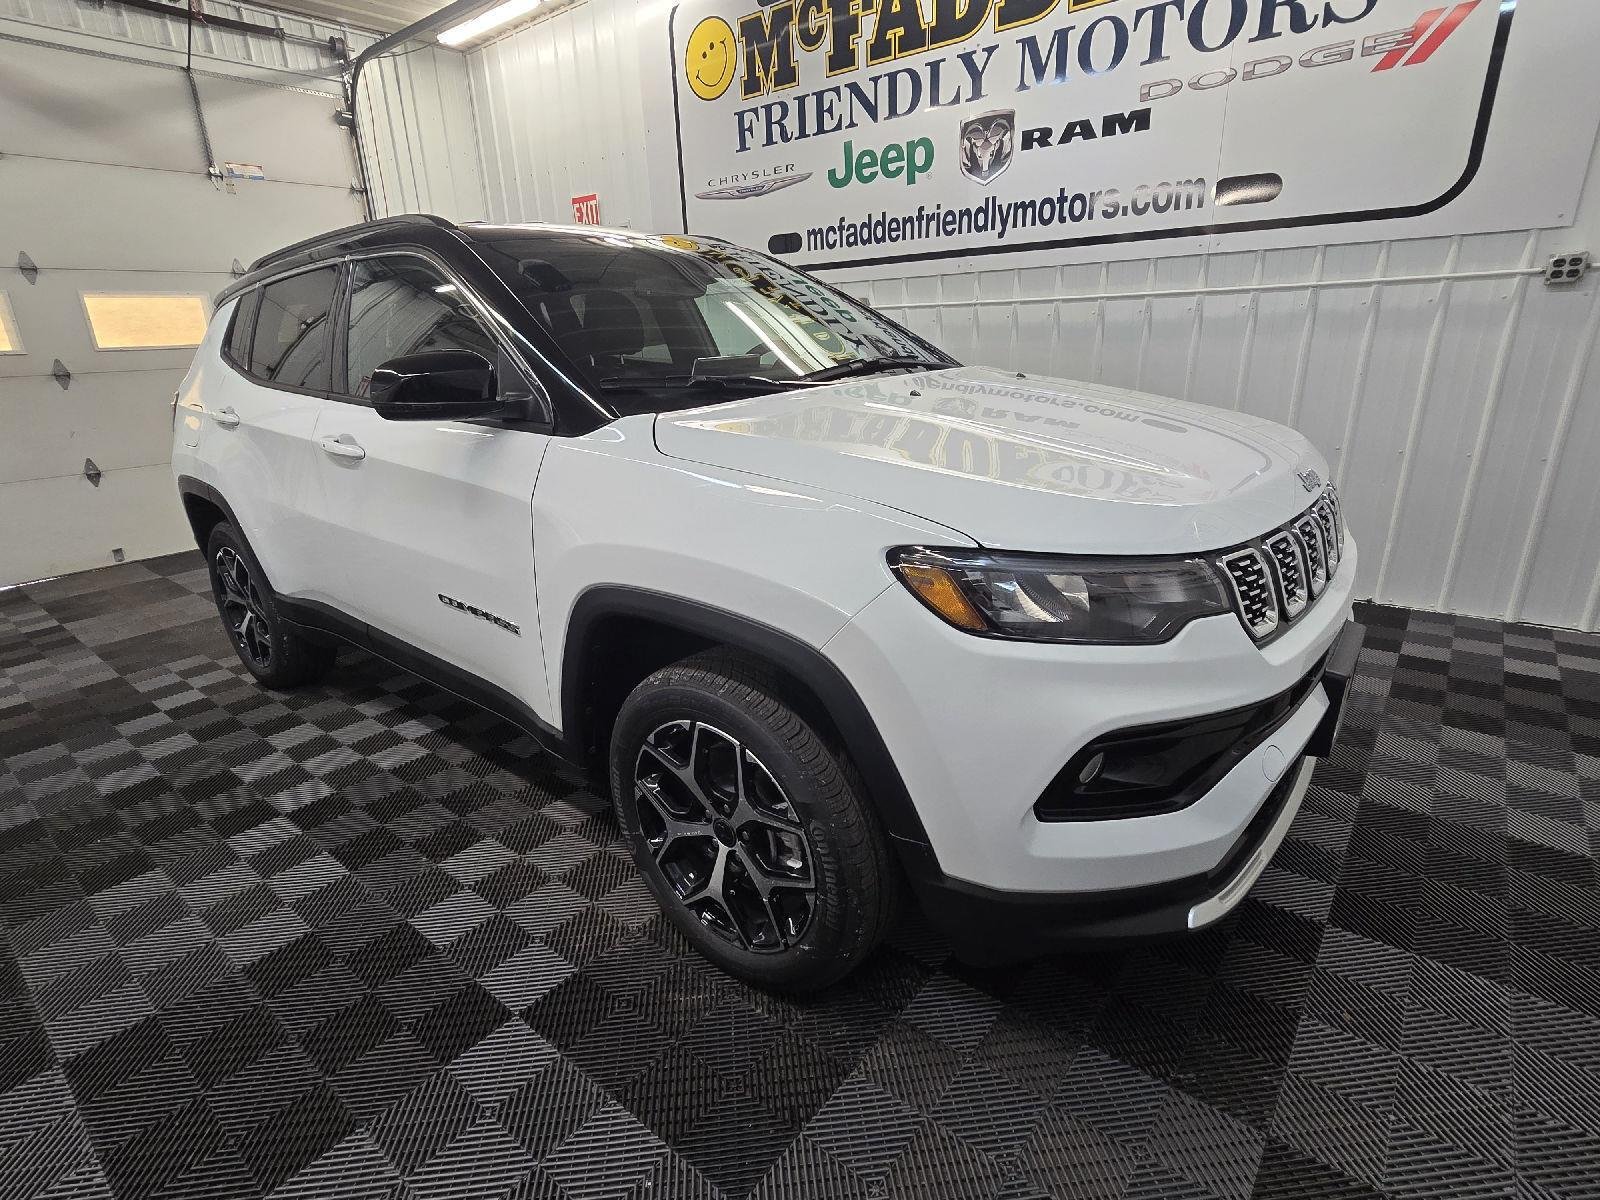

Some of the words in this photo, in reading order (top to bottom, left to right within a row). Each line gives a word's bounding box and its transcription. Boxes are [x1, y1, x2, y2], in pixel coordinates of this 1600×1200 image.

[1139, 26, 1415, 103] DODGE
[733, 43, 1000, 154] FRIENDLY
[1020, 107, 1152, 152] RAM
[707, 163, 796, 187] CHRYSLER
[827, 136, 935, 189] Jeep
[573, 199, 597, 225] EXIT
[806, 176, 1207, 251] mcfaddenfriendlymotors.com
